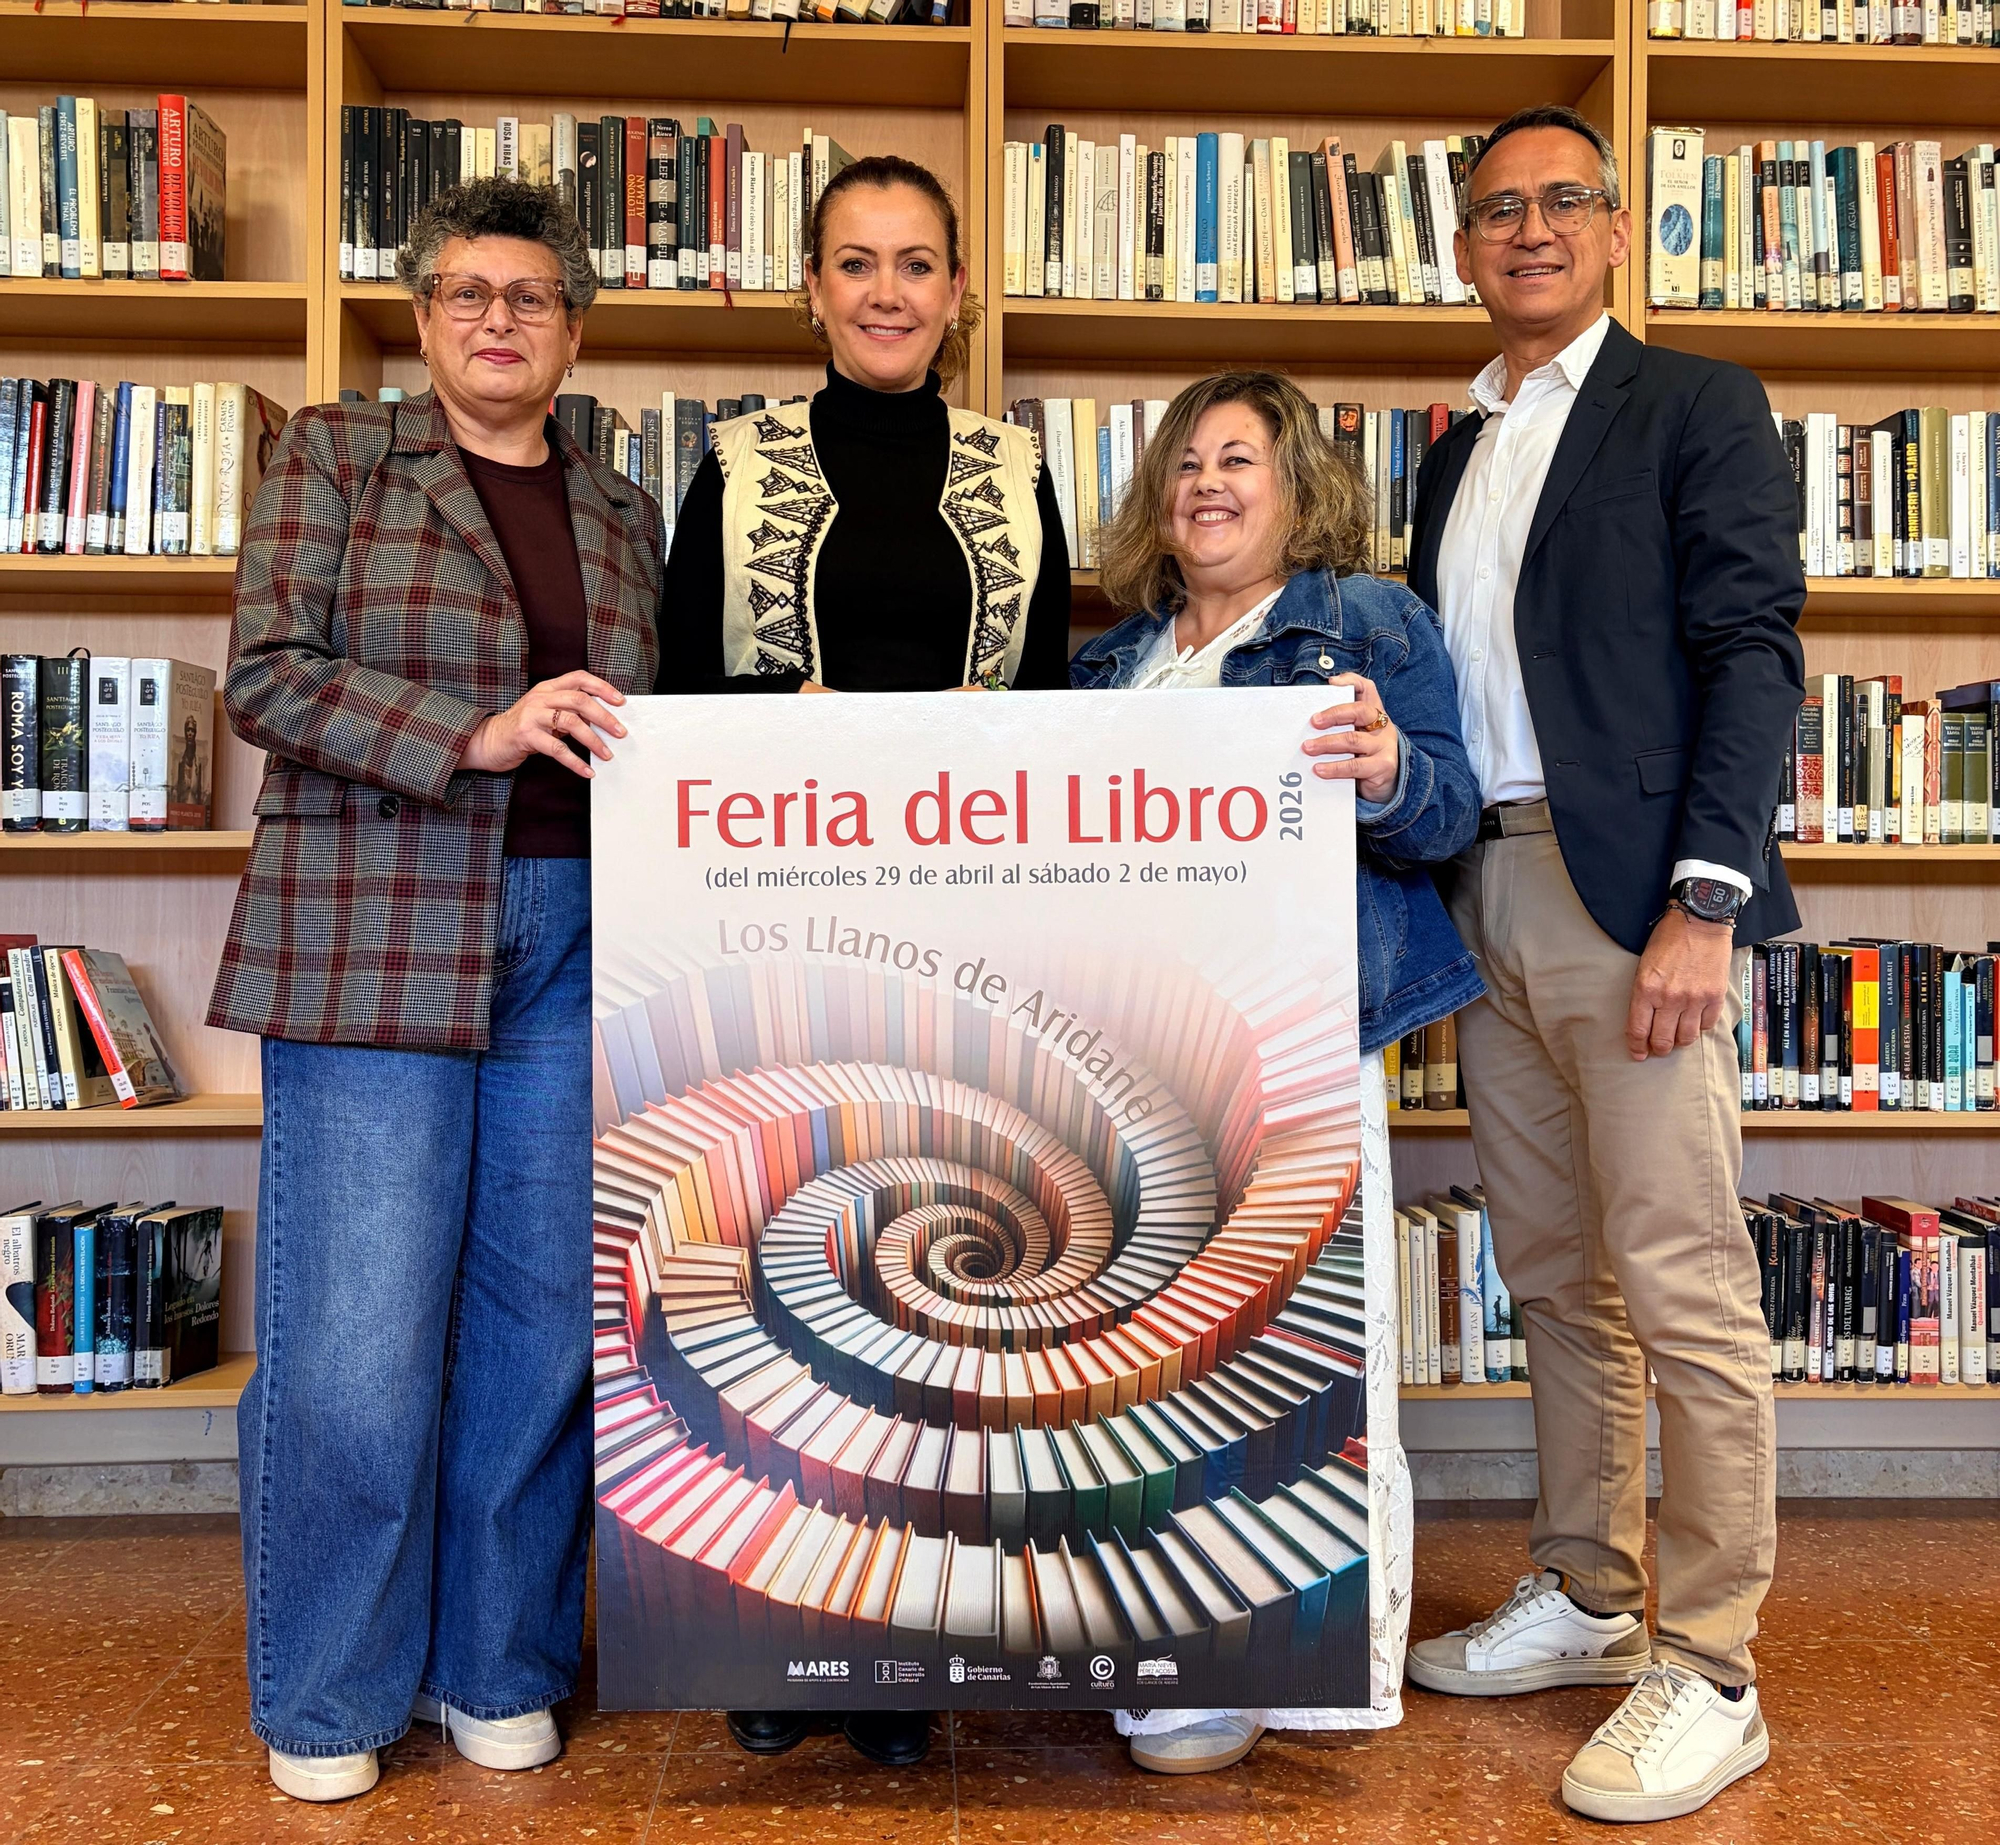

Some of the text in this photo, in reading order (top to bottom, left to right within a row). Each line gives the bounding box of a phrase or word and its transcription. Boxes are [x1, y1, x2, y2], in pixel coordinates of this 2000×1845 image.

[67, 122, 75, 152] ARTURO
[168, 108, 182, 167] ARTURO
[502, 122, 512, 166] ROSA RIBAS
[1334, 174, 1343, 205] Jardines
[1660, 170, 1697, 181] TOLKIEN
[70, 188, 76, 196] EL
[626, 174, 635, 216] EL OTOÑO
[636, 174, 645, 218] ALEMÁN
[658, 153, 668, 259] ELEFANTE MARFIL
[1848, 201, 1857, 229] AGUA
[1261, 230, 1269, 264] PRÍNCIPE
[227, 400, 235, 432] POSADAS
[220, 442, 234, 476] ROJA
[647, 433, 655, 470] RETORNO
[1904, 442, 1918, 541] CARNICERO PÁJARO
[57, 667, 69, 675] III
[11, 691, 24, 775] ROMA SOY
[53, 759, 60, 773] DE
[676, 768, 1268, 848] Feria del Libro
[1278, 770, 1303, 842] 2026
[704, 860, 1248, 890] (del miércoles 29 de abril al sábado 2 de mayo)
[12, 954, 25, 1016] Compañeras de viaje
[26, 974, 33, 983] mi
[51, 979, 59, 998] Música
[1886, 997, 1893, 1006] LA
[718, 915, 1154, 1124] Los Llanos de Aridane
[2, 1239, 11, 1264] negro
[12, 1226, 22, 1275] El albatros
[1816, 1232, 1824, 1258] LLAMAS
[195, 1300, 219, 1313] Dolores
[1844, 1286, 1852, 1314] TUAREG
[191, 1312, 219, 1326] Redondo
[787, 1660, 849, 1676] MARES
[967, 1665, 1003, 1674] Gobierno
[967, 1673, 1011, 1682] de Canarias
